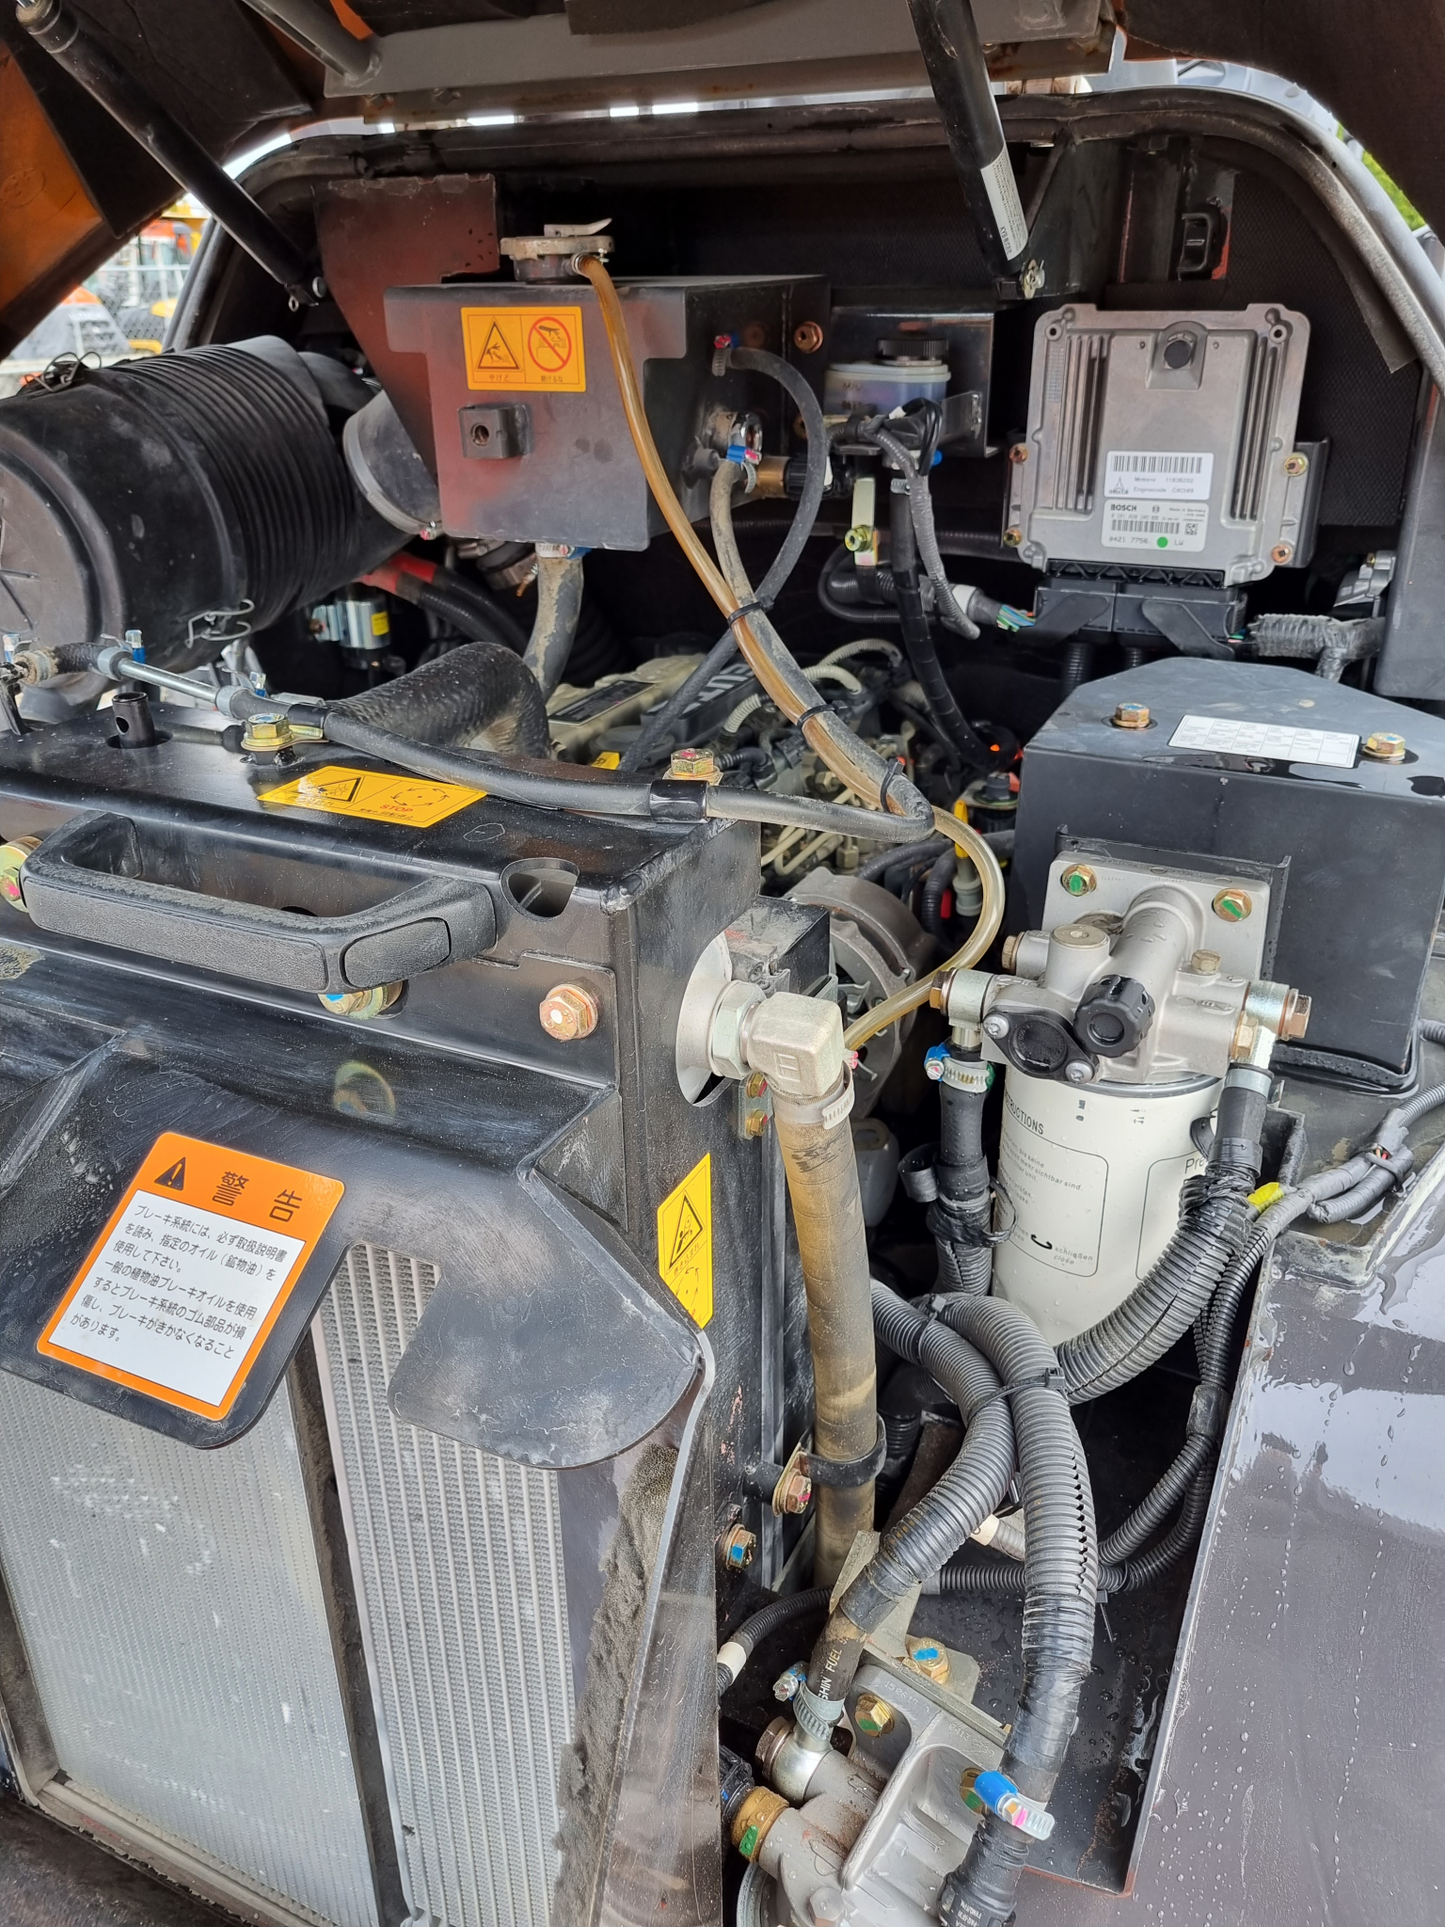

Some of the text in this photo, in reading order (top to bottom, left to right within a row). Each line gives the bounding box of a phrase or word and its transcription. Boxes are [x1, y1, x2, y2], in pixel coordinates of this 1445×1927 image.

[1110, 504, 1137, 512] BOSCH
[380, 803, 414, 813] STOP
[1034, 1168, 1063, 1185] sichtbar
[1064, 1179, 1084, 1191] sind.
[211, 1171, 303, 1223] 警告
[112, 1239, 183, 1274] 使用して下さい。
[1053, 1254, 1075, 1266] close
[70, 1313, 121, 1344] があります。
[825, 1648, 843, 1673] FUEL
